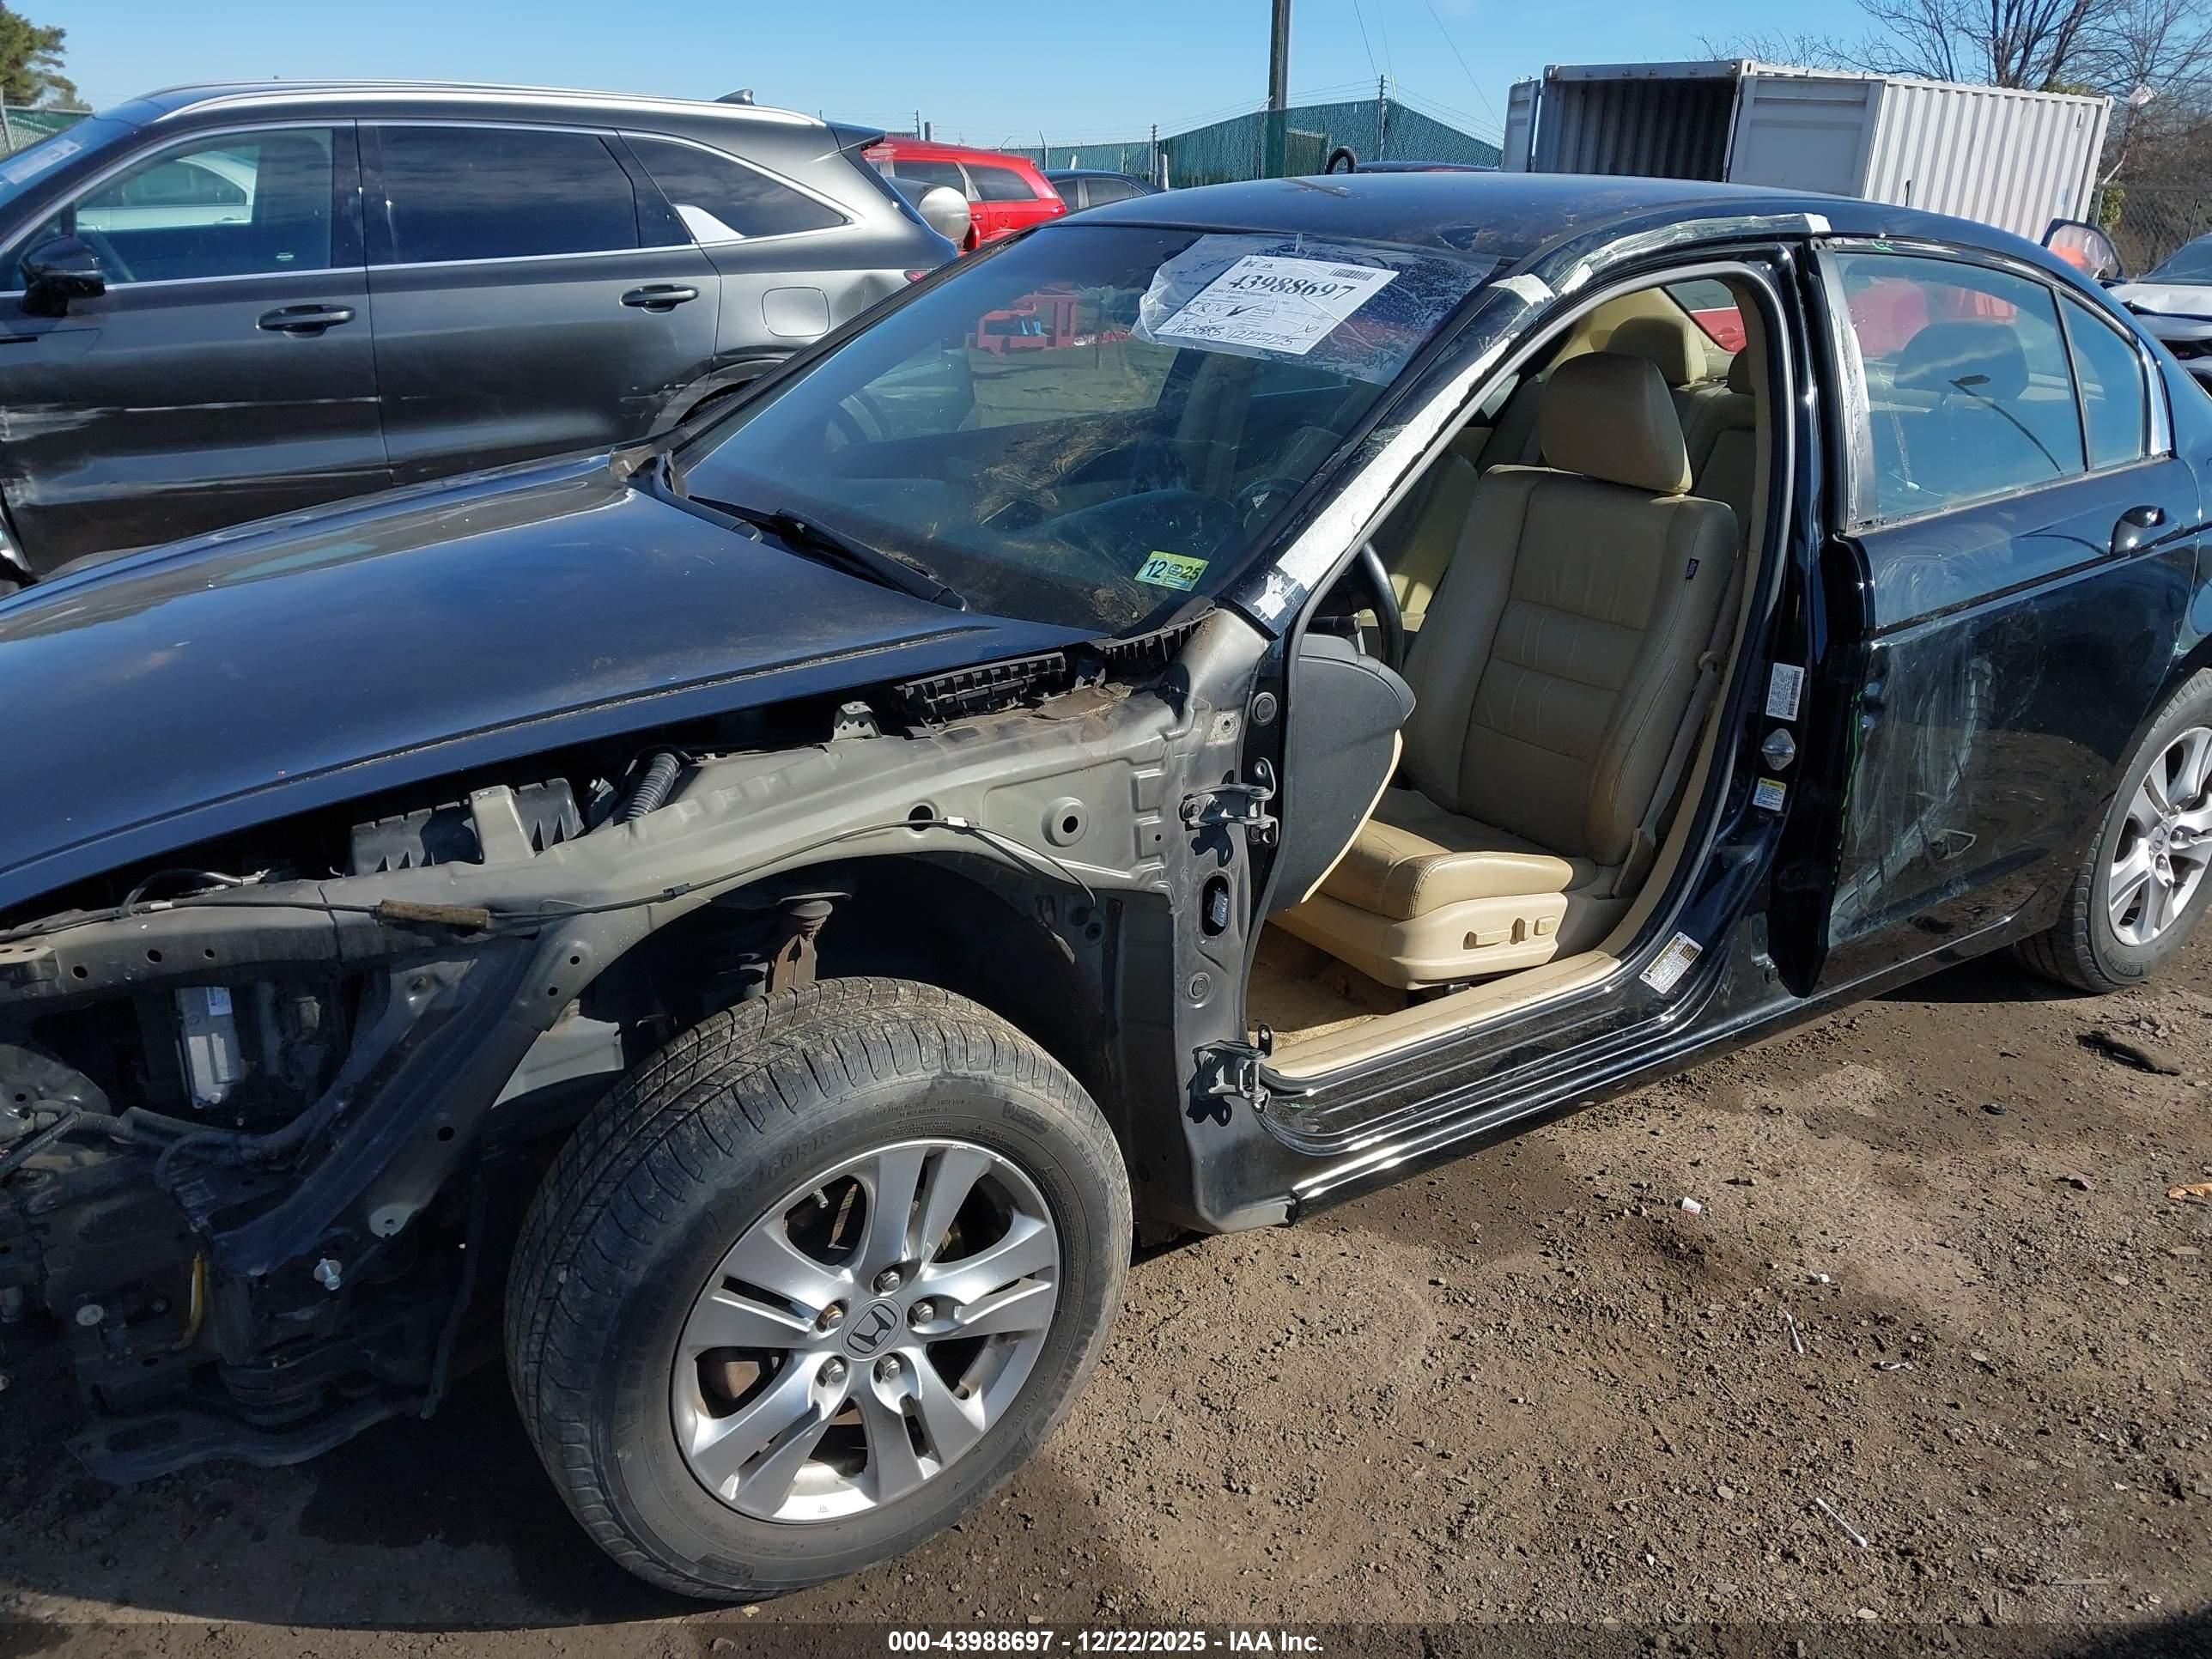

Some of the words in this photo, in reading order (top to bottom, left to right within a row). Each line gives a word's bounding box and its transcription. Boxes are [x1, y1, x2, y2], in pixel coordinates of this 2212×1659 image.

[1229, 274, 1358, 300] 43988697
[1146, 560, 1169, 579] 12
[1178, 566, 1202, 580] 25
